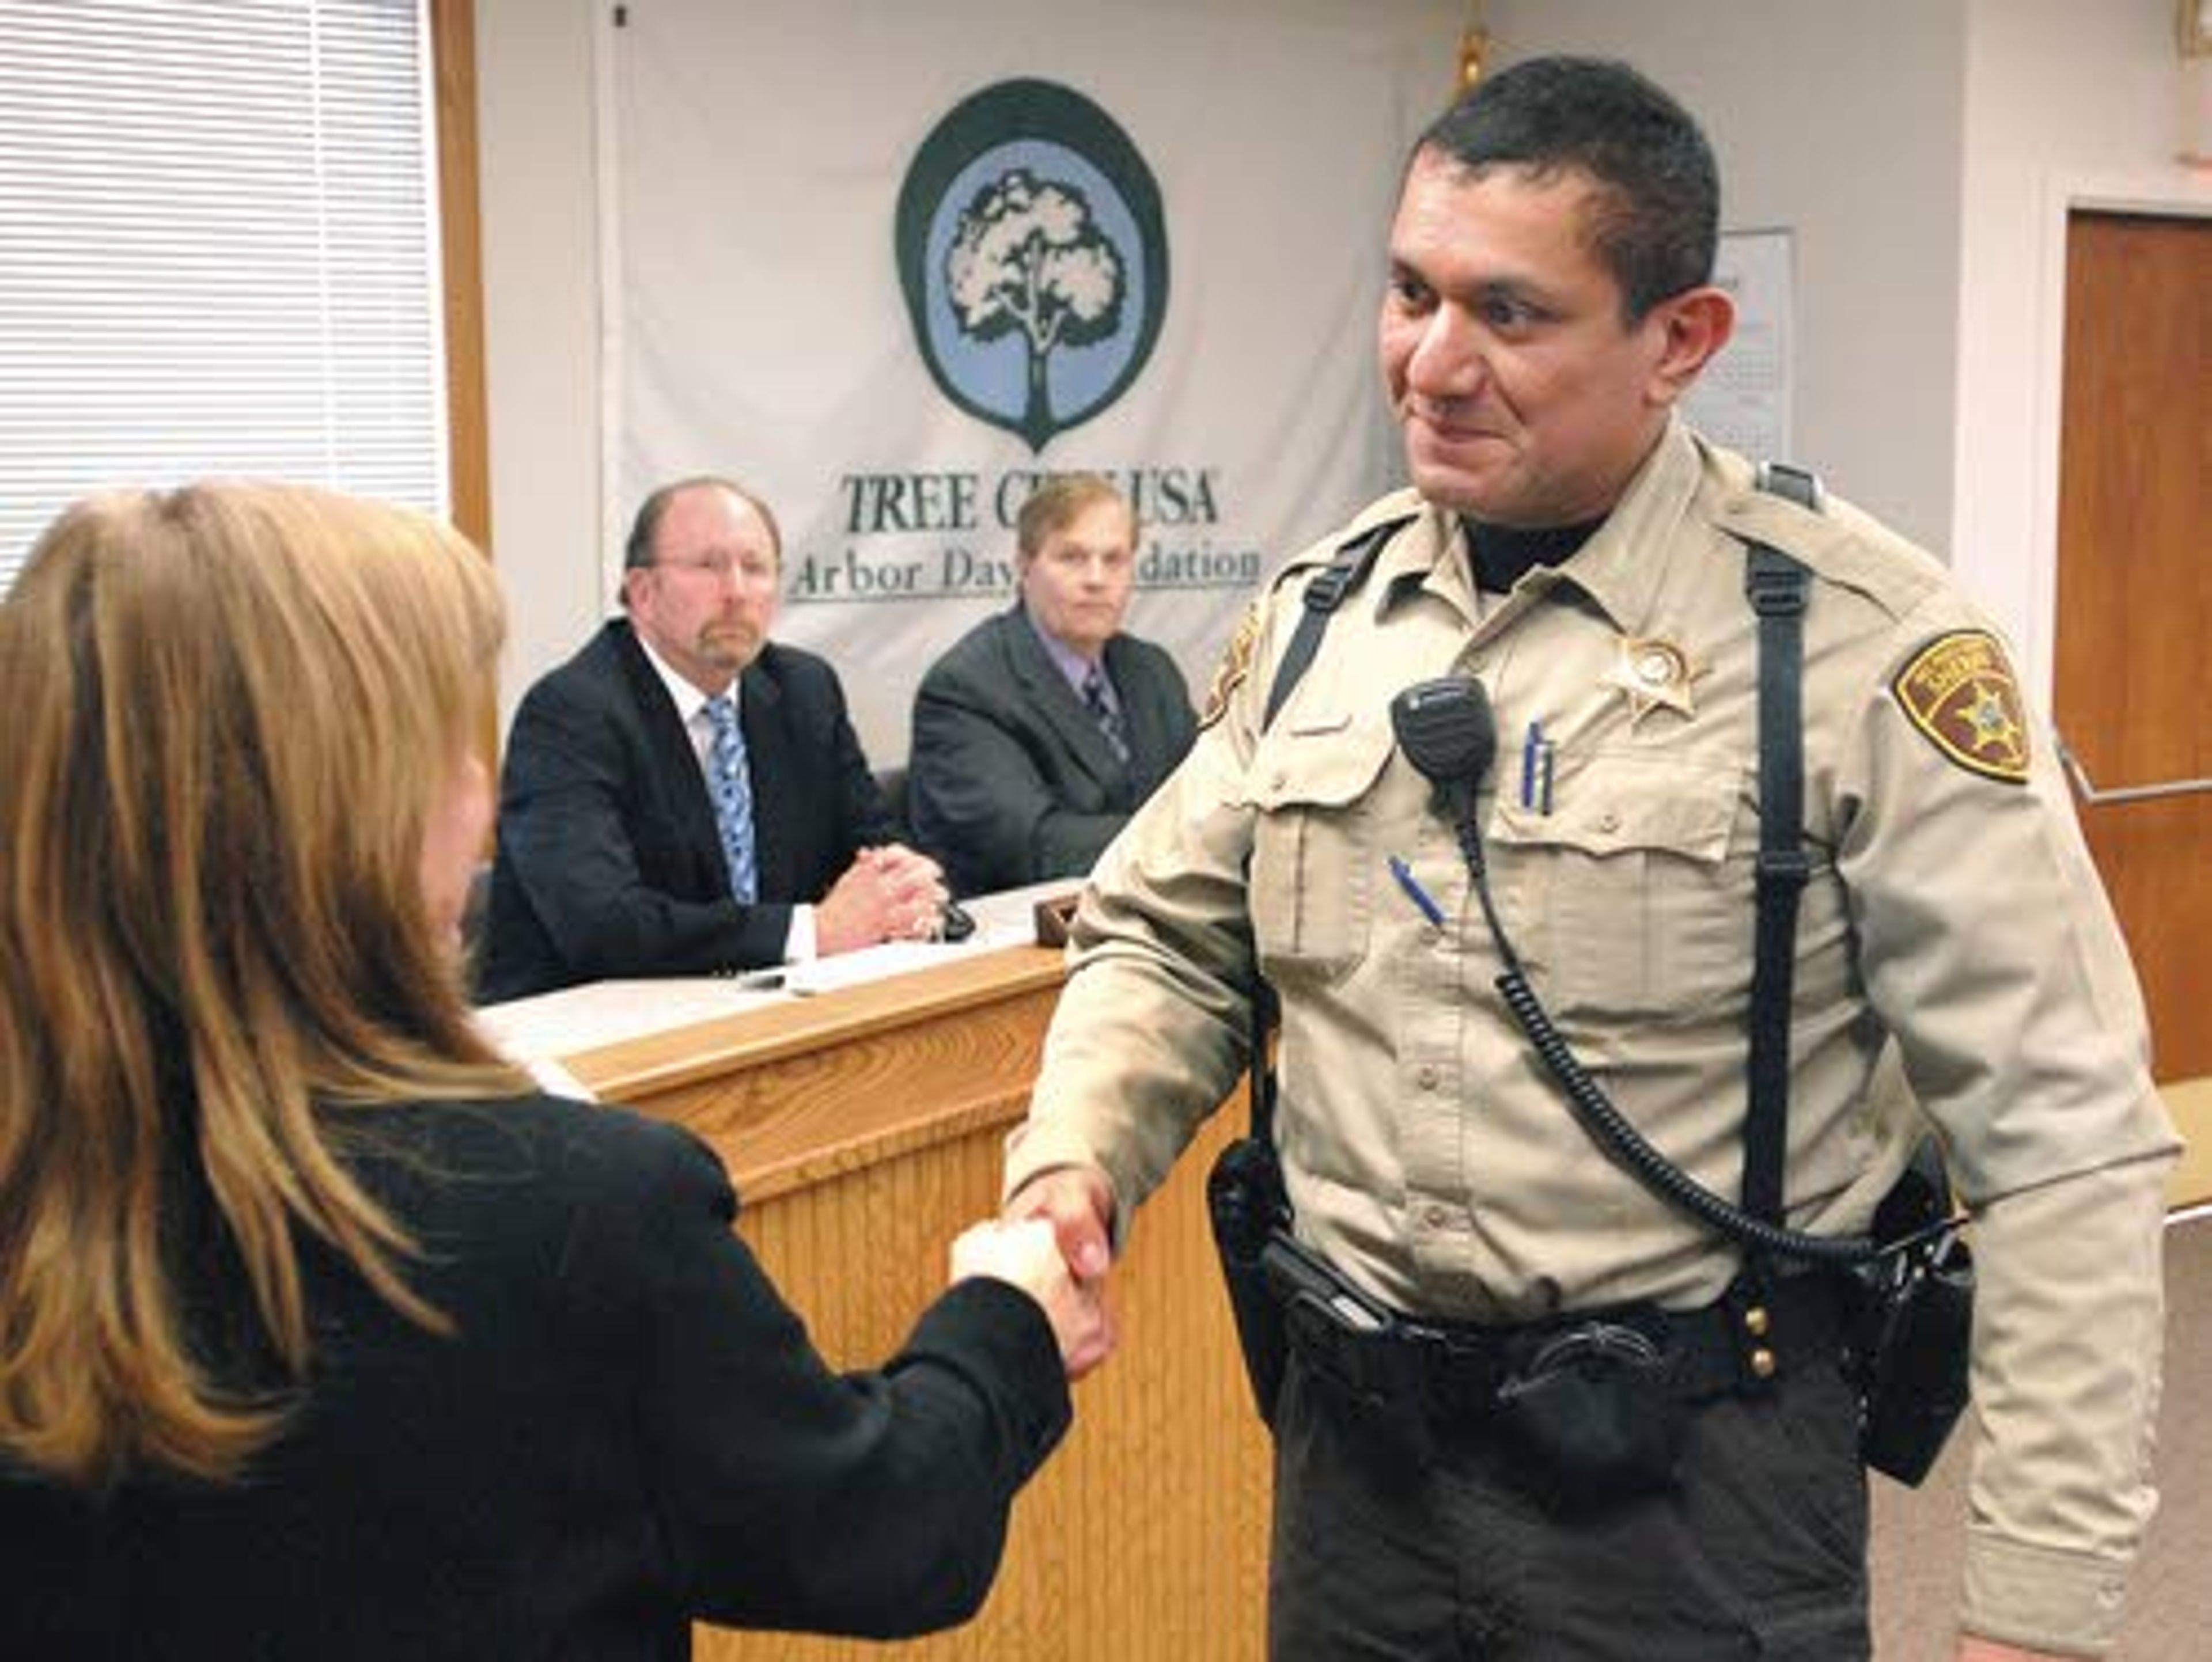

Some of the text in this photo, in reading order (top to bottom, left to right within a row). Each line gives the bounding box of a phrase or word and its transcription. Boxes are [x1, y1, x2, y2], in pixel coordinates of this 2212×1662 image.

[841, 473, 979, 533] TREE
[1130, 468, 1221, 525] USA
[788, 548, 923, 595] Arbor
[1138, 541, 1262, 582] dation
